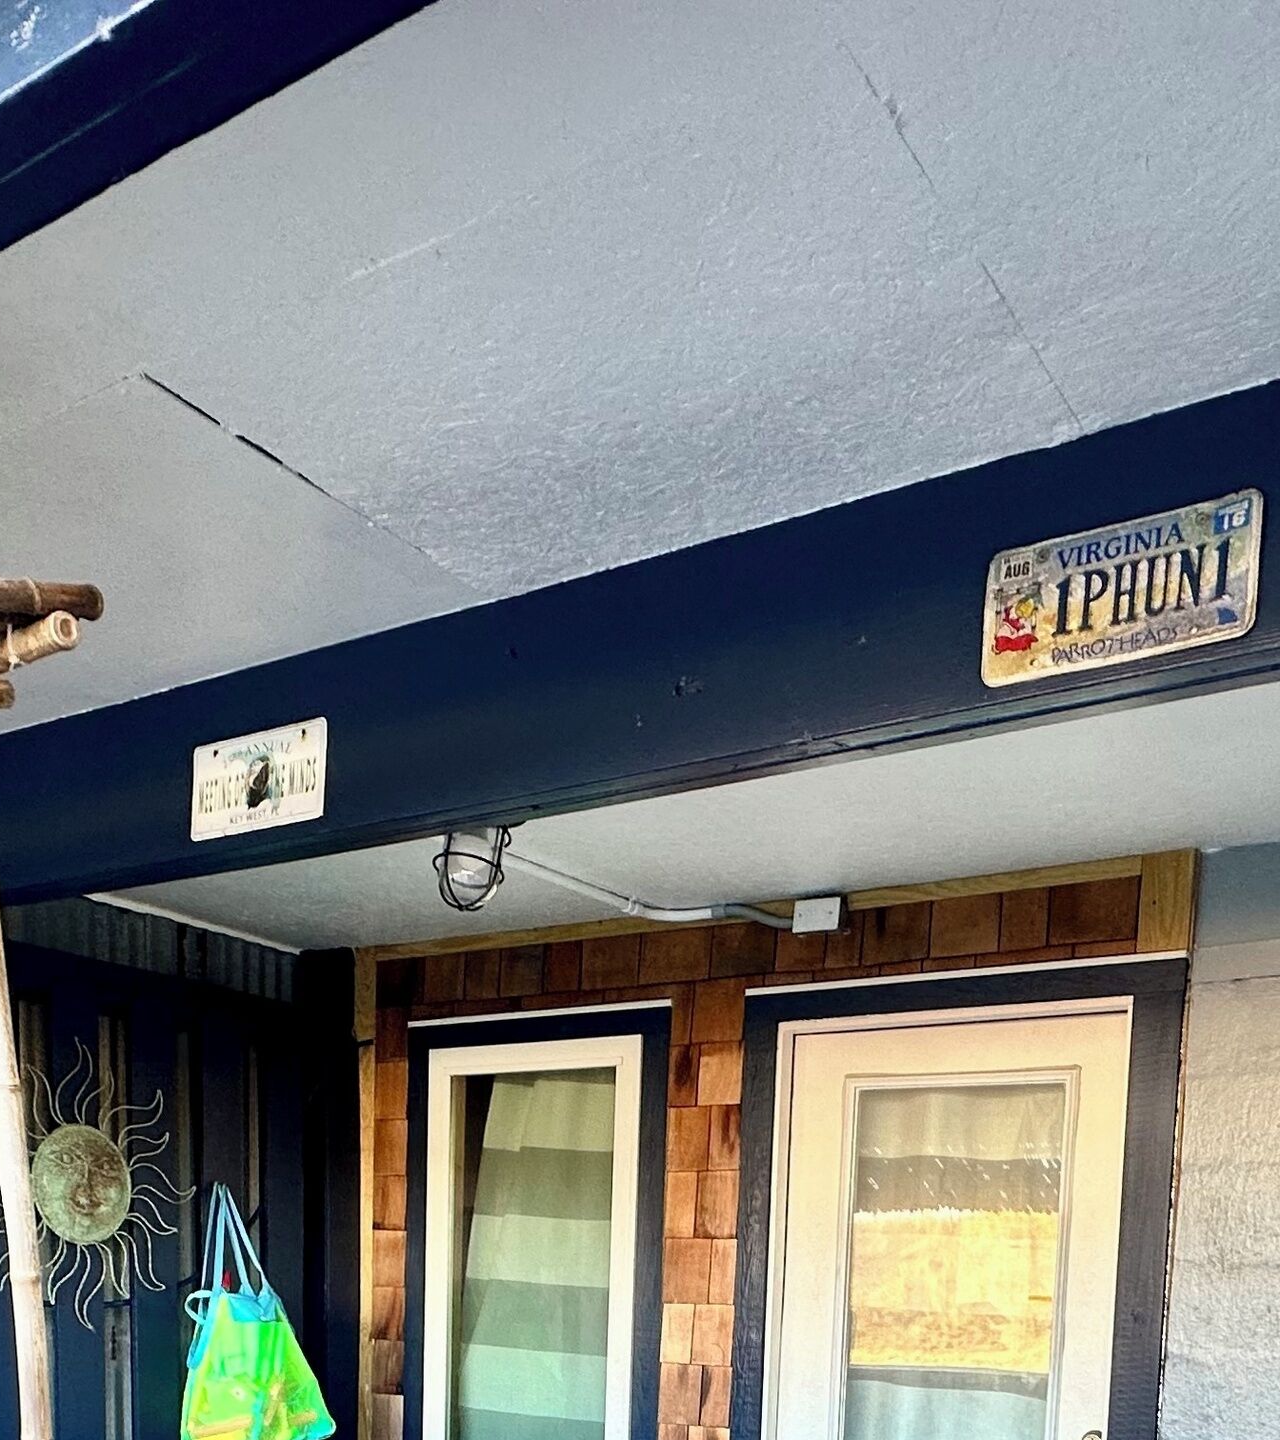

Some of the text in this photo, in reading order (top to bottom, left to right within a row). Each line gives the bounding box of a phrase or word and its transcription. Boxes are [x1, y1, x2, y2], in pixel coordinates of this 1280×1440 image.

[1057, 522, 1184, 569] VIRGINIA
[1003, 560, 1031, 580] AUG
[287, 757, 317, 797] MINDS
